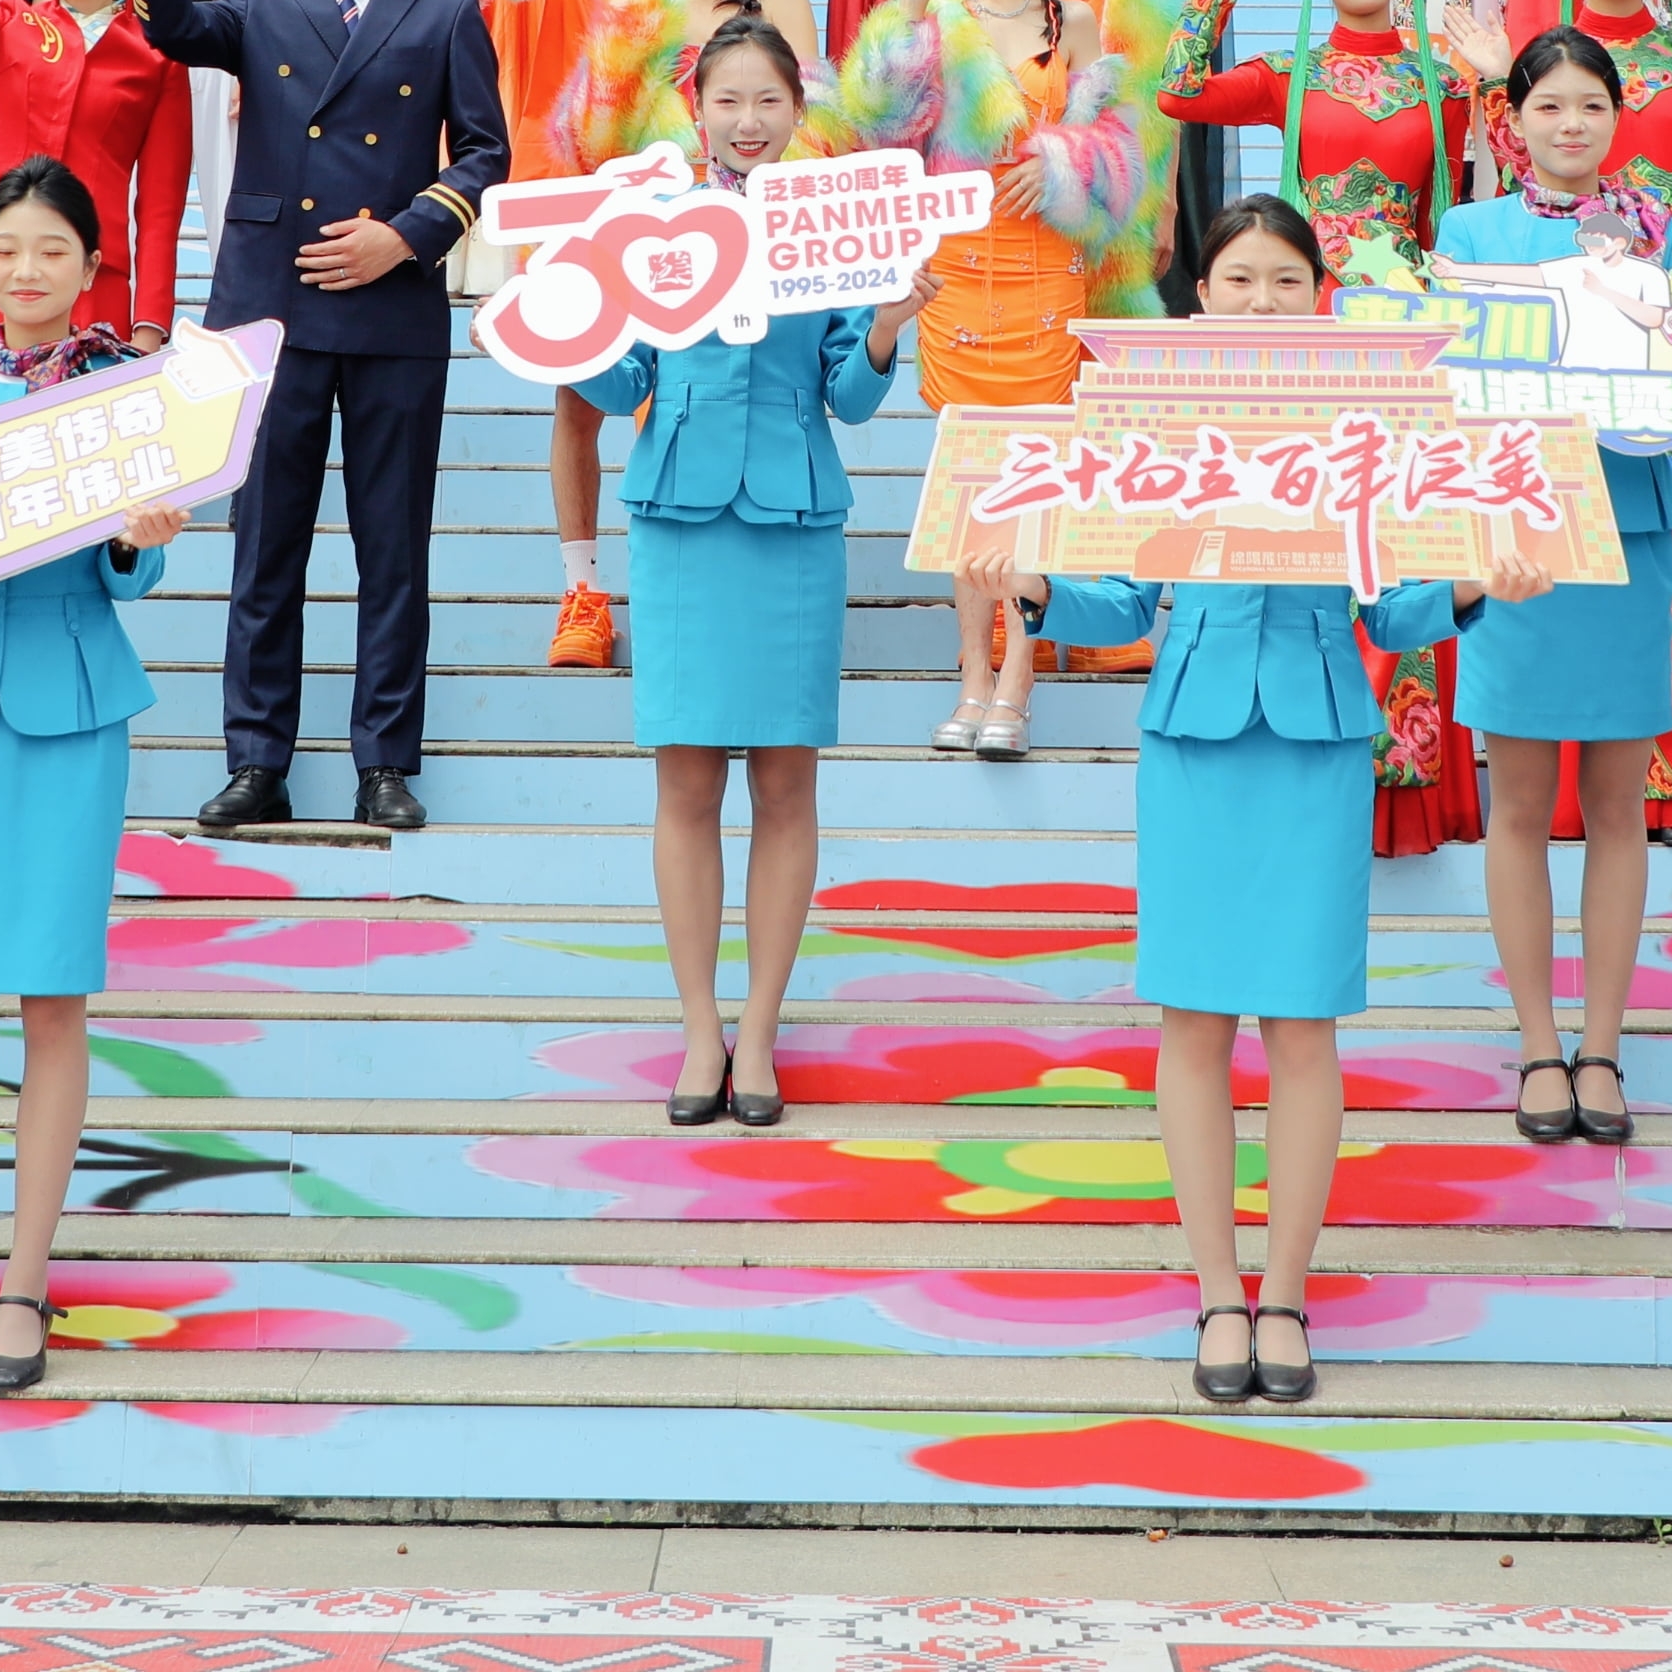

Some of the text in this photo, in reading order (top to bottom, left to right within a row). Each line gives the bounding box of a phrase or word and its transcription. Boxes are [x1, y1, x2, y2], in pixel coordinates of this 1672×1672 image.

[764, 165, 909, 202] 泛美30周年
[766, 186, 978, 238] PANMERIT
[768, 228, 923, 271] GROUP
[770, 267, 898, 299] 1995-2024
